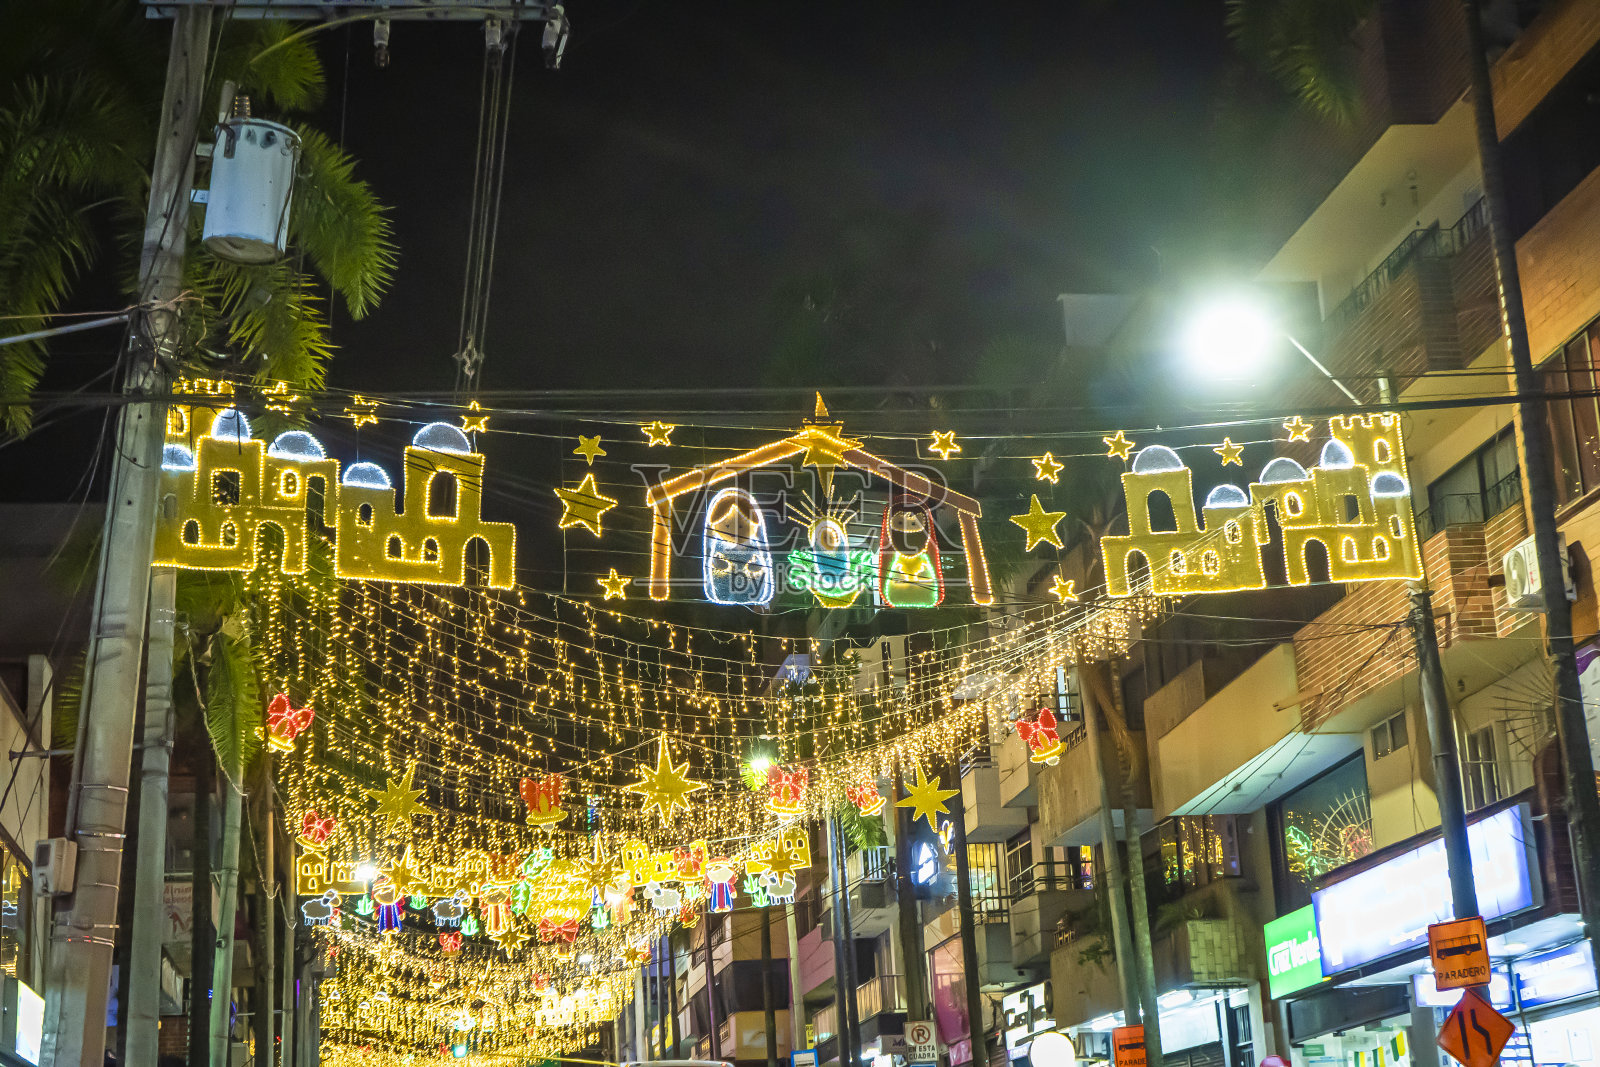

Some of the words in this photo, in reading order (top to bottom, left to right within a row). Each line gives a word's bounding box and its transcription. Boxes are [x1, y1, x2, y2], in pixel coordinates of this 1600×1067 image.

[1291, 931, 1320, 968] Verde
[1439, 966, 1486, 980] PARADERO
[1119, 1057, 1147, 1066] PARADE
